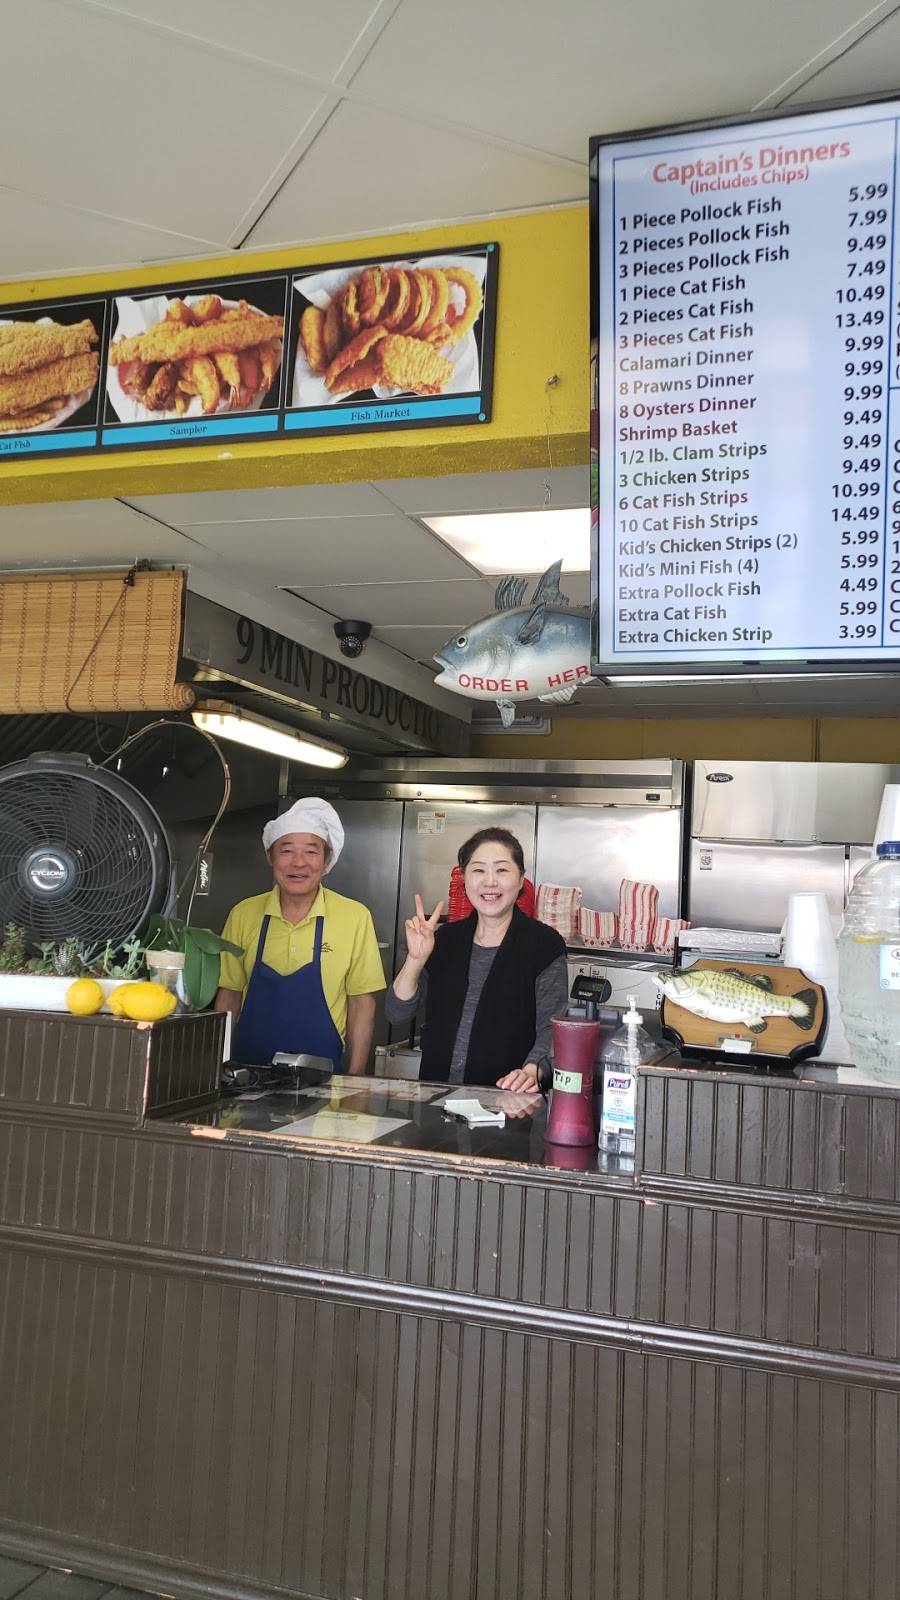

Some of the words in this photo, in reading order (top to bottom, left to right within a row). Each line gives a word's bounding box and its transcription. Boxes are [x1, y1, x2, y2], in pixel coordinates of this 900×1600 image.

[653, 152, 753, 184] Captain's
[760, 141, 850, 166] Dinners
[690, 176, 758, 196] (Includes
[762, 167, 810, 184] Chips)
[621, 218, 626, 230] 1
[634, 214, 676, 229] Piece
[680, 202, 742, 223] Pollock
[747, 197, 782, 214] Fish
[849, 184, 888, 202] 5.99
[620, 241, 628, 254] 2
[634, 234, 684, 252] Pieces
[689, 225, 750, 246] Pollock
[756, 221, 790, 239] Fish
[848, 209, 887, 228] 7.99
[620, 265, 628, 278] 3
[634, 259, 684, 276] Pieces
[689, 250, 750, 270] Pollock
[755, 246, 789, 263] Fish
[848, 235, 886, 252] 9.49
[621, 289, 626, 301] 1
[634, 284, 676, 300] Piece
[680, 279, 707, 295] Cat
[712, 275, 746, 292] Fish
[847, 260, 886, 278] 7.49
[620, 312, 628, 325] 2
[634, 306, 683, 324] Pieces
[688, 302, 715, 318] Cat
[720, 299, 753, 315] Fish
[836, 286, 885, 304] 10.49
[620, 336, 628, 348] 3
[634, 330, 683, 347] Pieces
[688, 326, 715, 342] Cat
[720, 322, 753, 338] Fish
[836, 310, 884, 329] 13.49
[620, 352, 691, 372] Calamari
[696, 348, 754, 366] Dinner
[845, 336, 884, 352] 9.99
[620, 382, 628, 396] 8
[634, 377, 692, 394] Prawns
[696, 372, 754, 389] Dinner
[844, 360, 883, 377] 9.99
[351, 411, 371, 421] Fish
[374, 408, 410, 420] Market
[620, 406, 628, 418] 8
[633, 400, 694, 418] Oysters
[699, 396, 756, 412] Dinner
[844, 385, 882, 401] 9.99
[170, 425, 208, 436] Sampler
[620, 424, 677, 442] Shrimp
[683, 420, 738, 436] Basket
[844, 410, 882, 426] 9.49
[14, 440, 32, 448] Fish
[620, 449, 644, 464] 1/2
[649, 448, 668, 462] lb.
[673, 445, 714, 460] Clam
[719, 442, 768, 459] Strips
[843, 434, 881, 450] 9.49
[620, 474, 628, 488] 3
[633, 470, 696, 486] Chicken
[702, 467, 750, 484] Strips
[842, 458, 880, 474] 9.49
[620, 496, 628, 510] 6
[633, 495, 658, 509] Cat
[664, 492, 695, 507] Fish
[700, 490, 748, 506] Strips
[832, 482, 880, 498] 10.99
[620, 520, 638, 532] 10
[642, 518, 668, 532] Cat
[673, 515, 705, 530] Fish
[710, 512, 758, 529] Strips
[832, 506, 879, 522] 14.49
[620, 540, 655, 555] Kid's
[660, 536, 722, 553] Chicken
[726, 534, 772, 550] Strips
[776, 533, 798, 550] (2)
[842, 530, 879, 544] 5.99
[620, 563, 655, 578] Kid's
[660, 560, 695, 576] Mini
[700, 560, 732, 574] Fish
[738, 558, 759, 574] (4)
[841, 554, 878, 568] 5.99
[619, 586, 658, 600] Extra
[664, 583, 723, 598] Pollock
[728, 582, 760, 596] Fish
[840, 578, 878, 592] 4.49
[619, 608, 659, 621] Extra
[663, 606, 690, 620] Cat
[694, 605, 726, 619] Fish
[840, 601, 877, 615] 5.99
[618, 630, 658, 644] Extra
[663, 628, 728, 642] Chicken
[732, 628, 772, 644] Strip
[839, 625, 876, 638] 3.99
[235, 616, 255, 664] 9
[259, 626, 314, 692] MIN
[458, 673, 529, 692] ORDER
[555, 1071, 571, 1086] Tip
